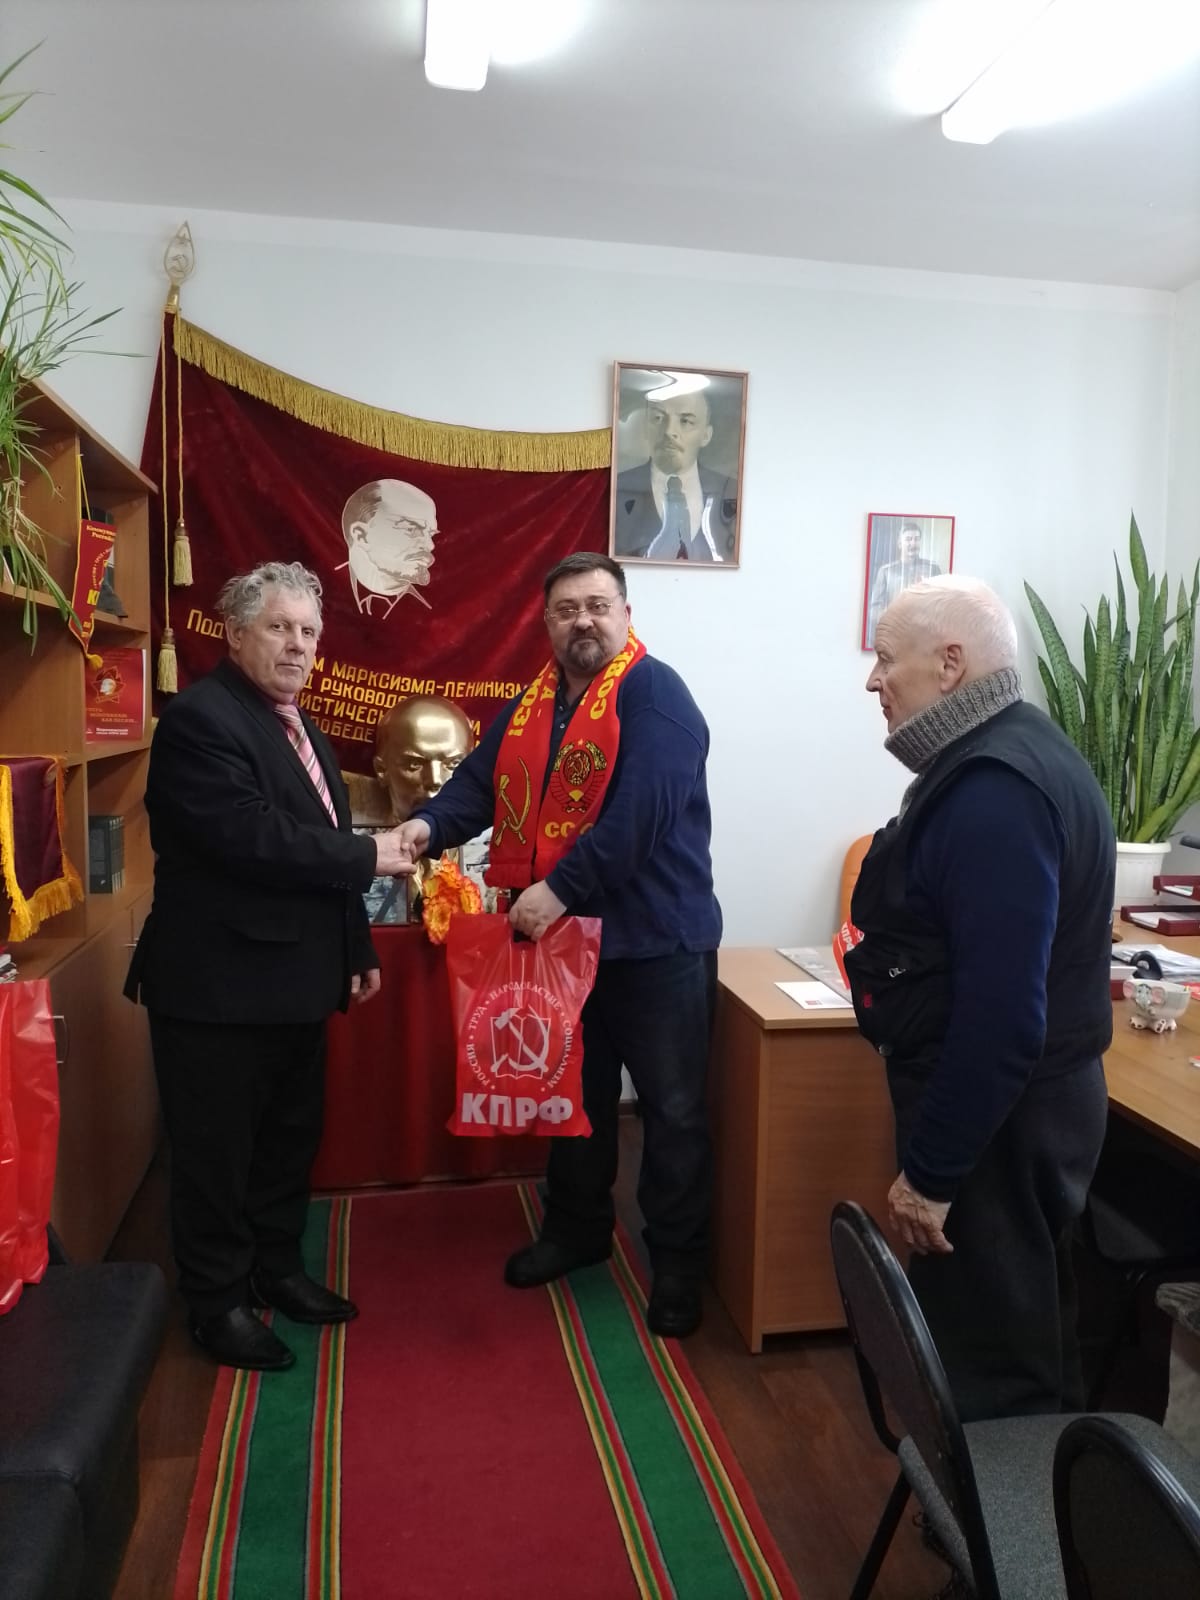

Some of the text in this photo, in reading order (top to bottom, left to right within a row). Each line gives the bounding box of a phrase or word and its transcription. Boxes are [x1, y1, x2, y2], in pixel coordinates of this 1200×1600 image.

[187, 608, 225, 640] Под
[312, 656, 325, 673] М
[332, 661, 526, 699] МАРКСИЗМА-ЛЕНИНИЗМ
[320, 677, 407, 709] РУКОВОД
[590, 627, 639, 720] СОВЕТ
[469, 1005, 488, 1030] ТРУД
[466, 1043, 490, 1087] РОССИЯ
[461, 1092, 574, 1127] КПРФ
